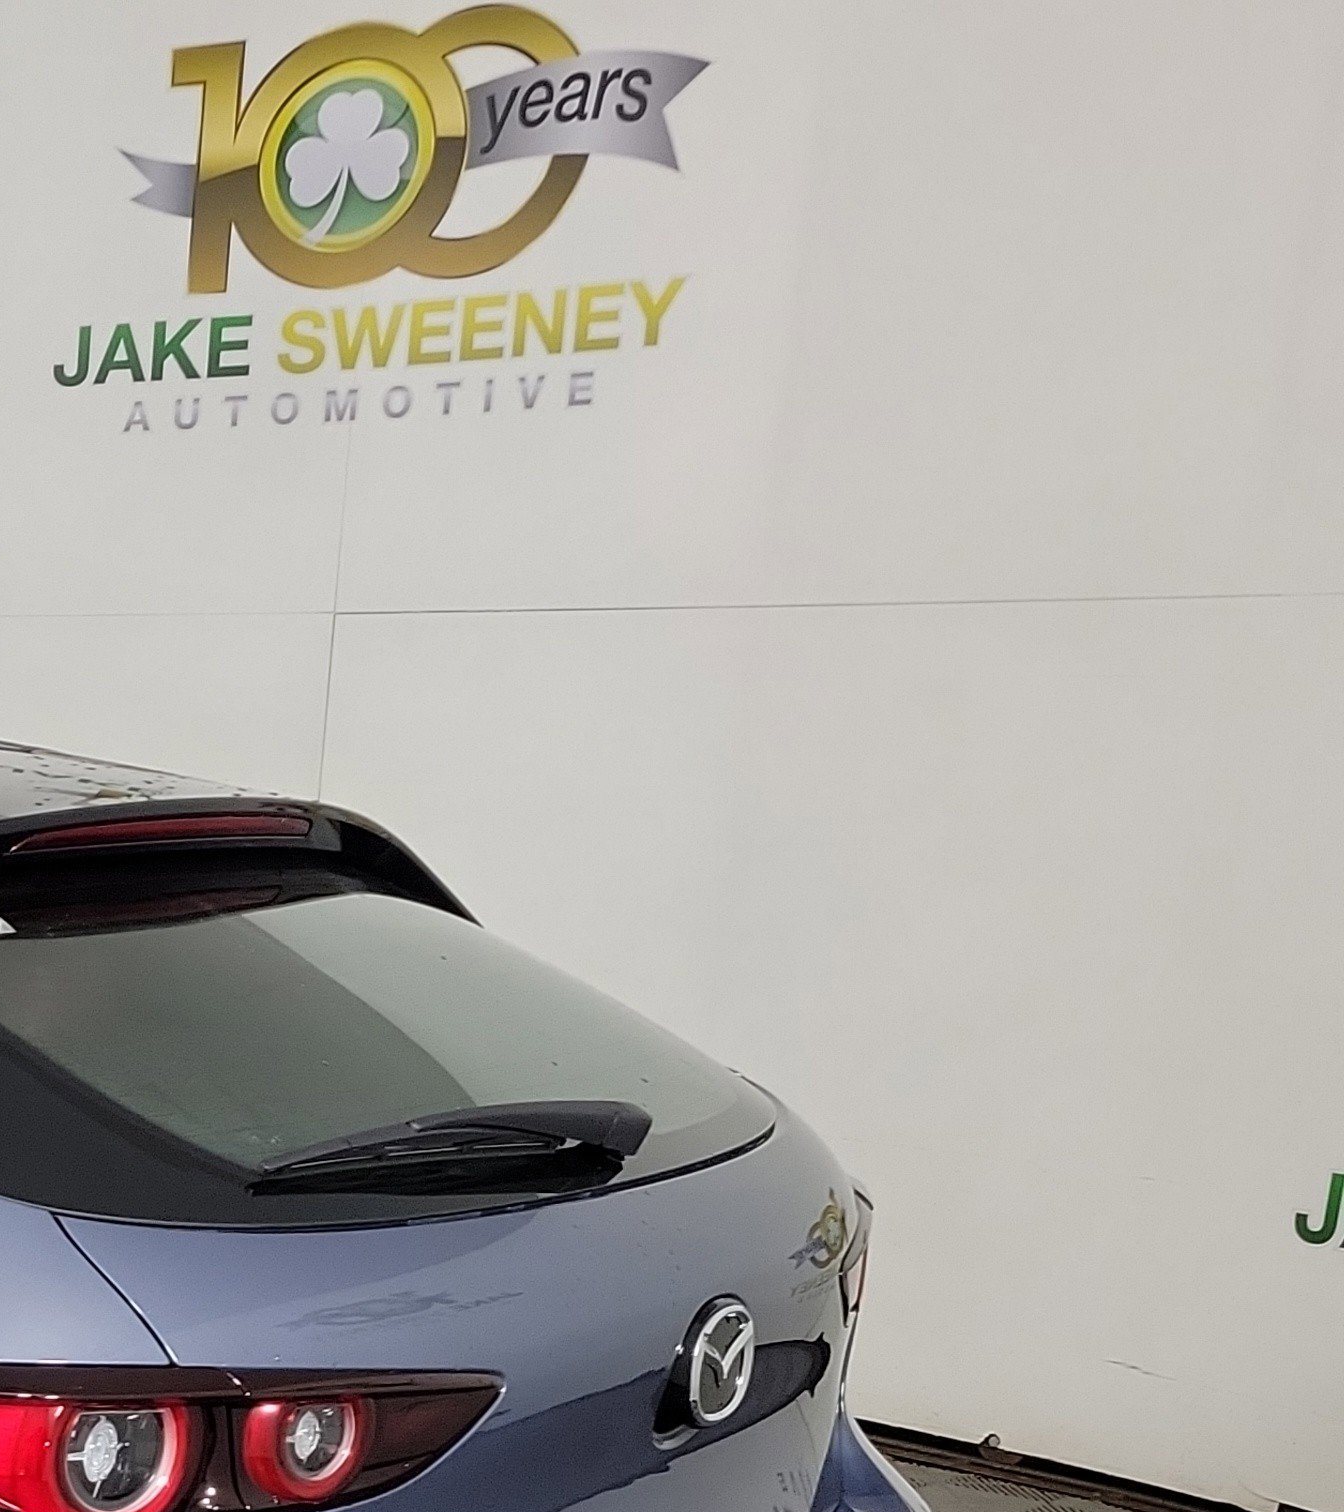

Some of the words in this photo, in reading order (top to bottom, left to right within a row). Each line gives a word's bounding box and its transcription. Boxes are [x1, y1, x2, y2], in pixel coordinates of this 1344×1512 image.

[480, 63, 653, 155] years
[52, 314, 254, 388] JAKE
[276, 276, 686, 375] SWEENEY
[122, 371, 596, 434] AUTOMOTIVE
